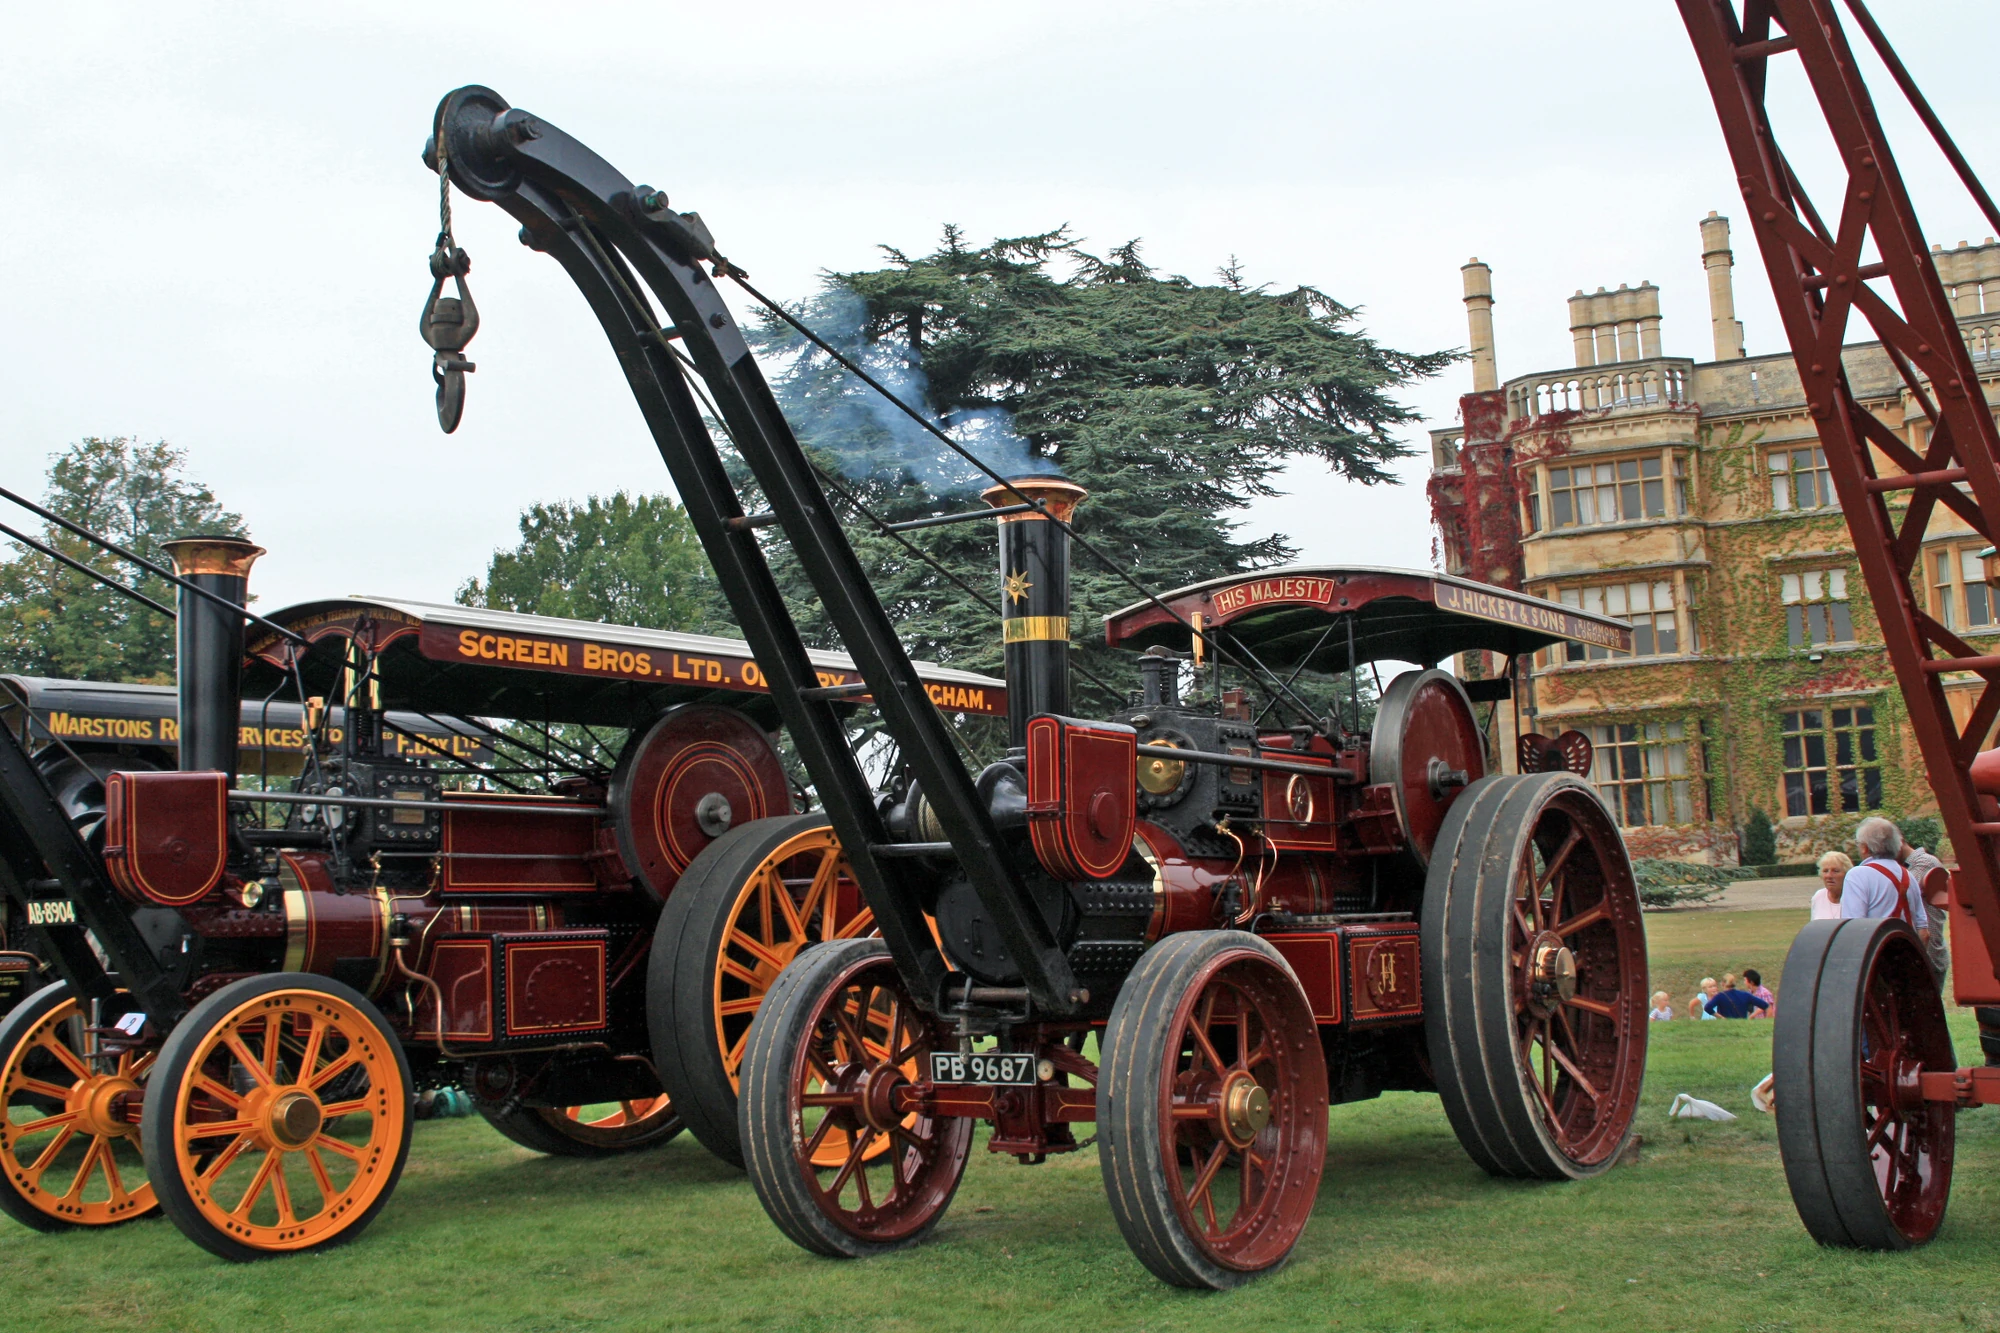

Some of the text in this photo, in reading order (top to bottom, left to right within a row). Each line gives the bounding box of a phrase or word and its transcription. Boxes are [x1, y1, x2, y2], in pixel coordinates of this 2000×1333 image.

[1219, 579, 1329, 611] HIS MAJESTY
[1520, 603, 1530, 625] &
[1531, 607, 1566, 634] SONS
[458, 630, 568, 667] SCREEN
[583, 643, 662, 678] BROS.
[673, 653, 731, 684] LTD.
[49, 711, 153, 739] MARSTONS
[27, 901, 75, 925] AB-8904
[935, 1057, 1029, 1082] PB 9687
